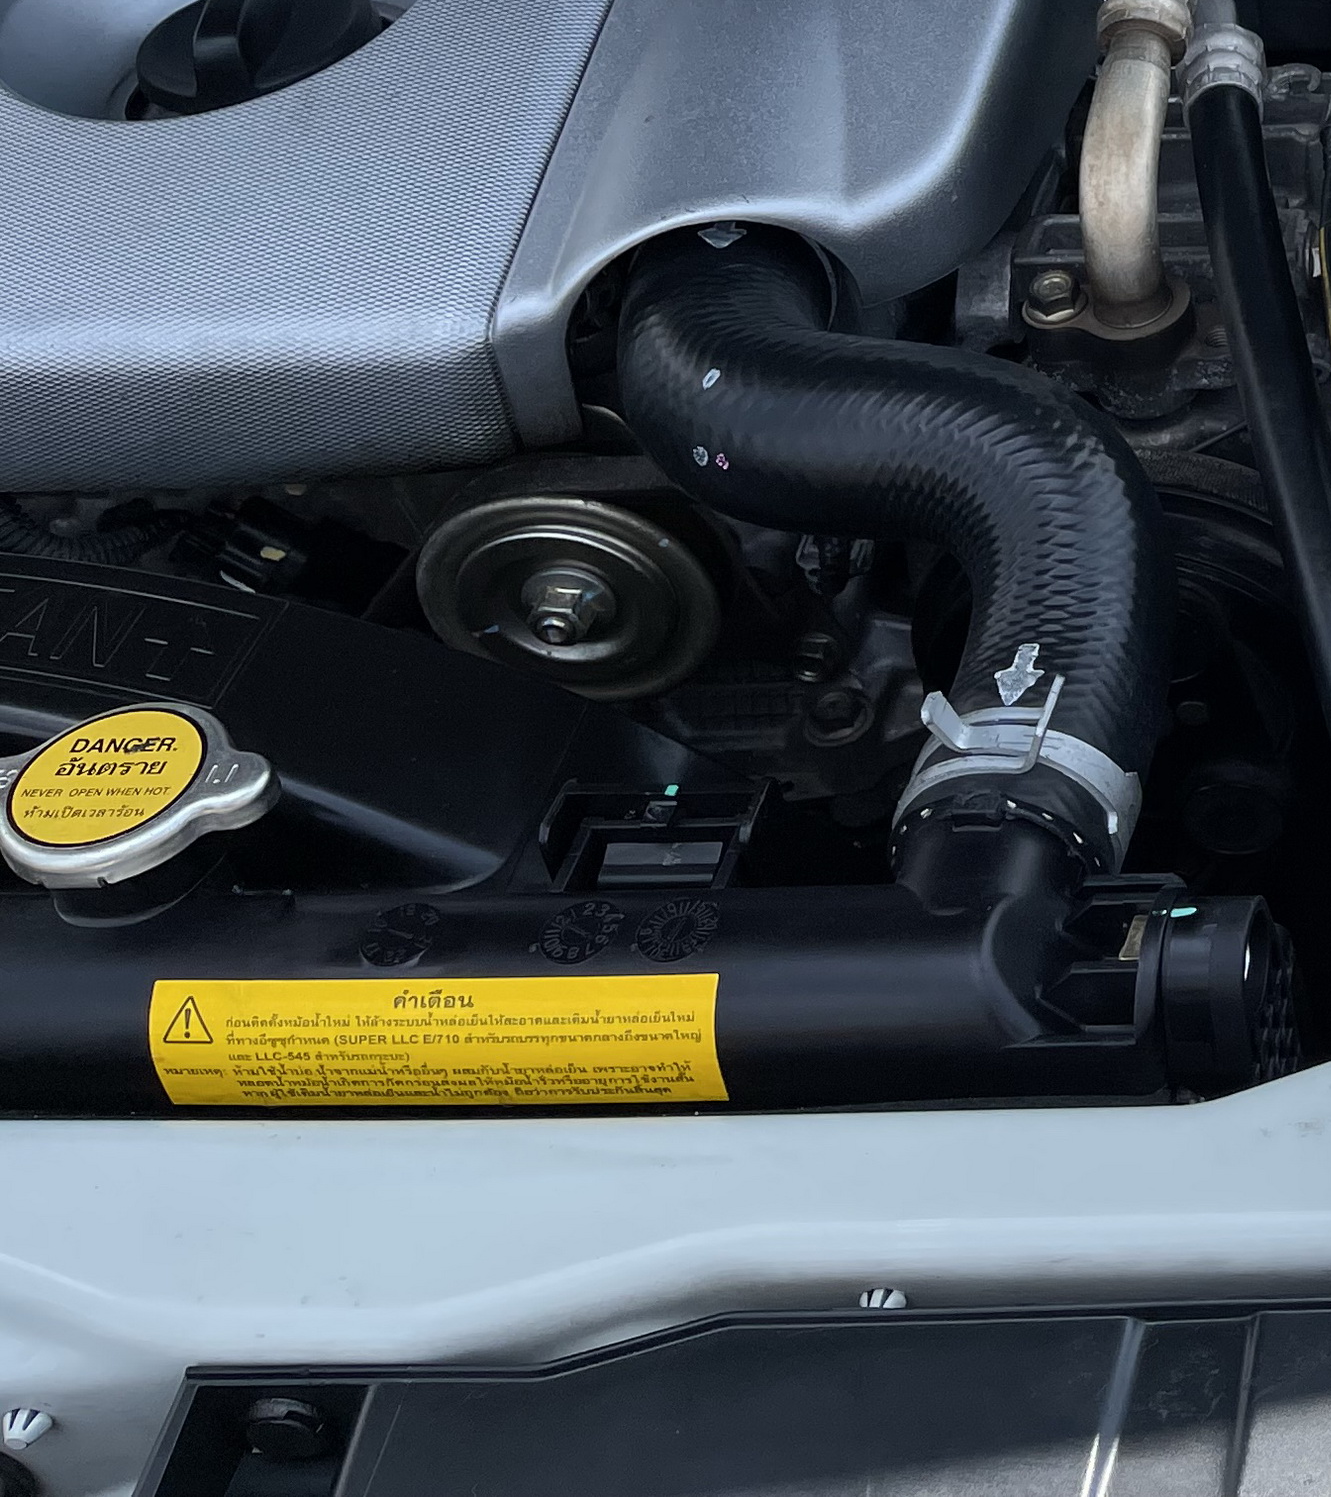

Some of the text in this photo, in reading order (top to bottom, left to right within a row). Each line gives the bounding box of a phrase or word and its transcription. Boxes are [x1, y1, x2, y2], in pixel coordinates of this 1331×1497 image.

[54, 757, 168, 777] อันตราย
[205, 763, 239, 784] 1.1
[20, 787, 64, 798] NEVER
[69, 786, 104, 798] OPEN
[105, 786, 141, 797] WHEN
[23, 804, 146, 820] ห้ามเปิดเวลาร้อน
[584, 902, 596, 916] 2
[595, 903, 607, 917] 3
[566, 946, 579, 960] 8
[392, 989, 475, 1010] คำเตือน
[225, 1013, 351, 1029] ก่อนติดตั้งหม้อน้ำใหม่
[225, 1033, 331, 1049] ที่ทางอีซูซุกำหนด
[334, 1034, 387, 1047] (SUPER
[391, 1034, 419, 1045] LLC
[423, 1033, 461, 1045] E/710
[228, 1053, 253, 1062] และ
[255, 1051, 311, 1062] LLC-545
